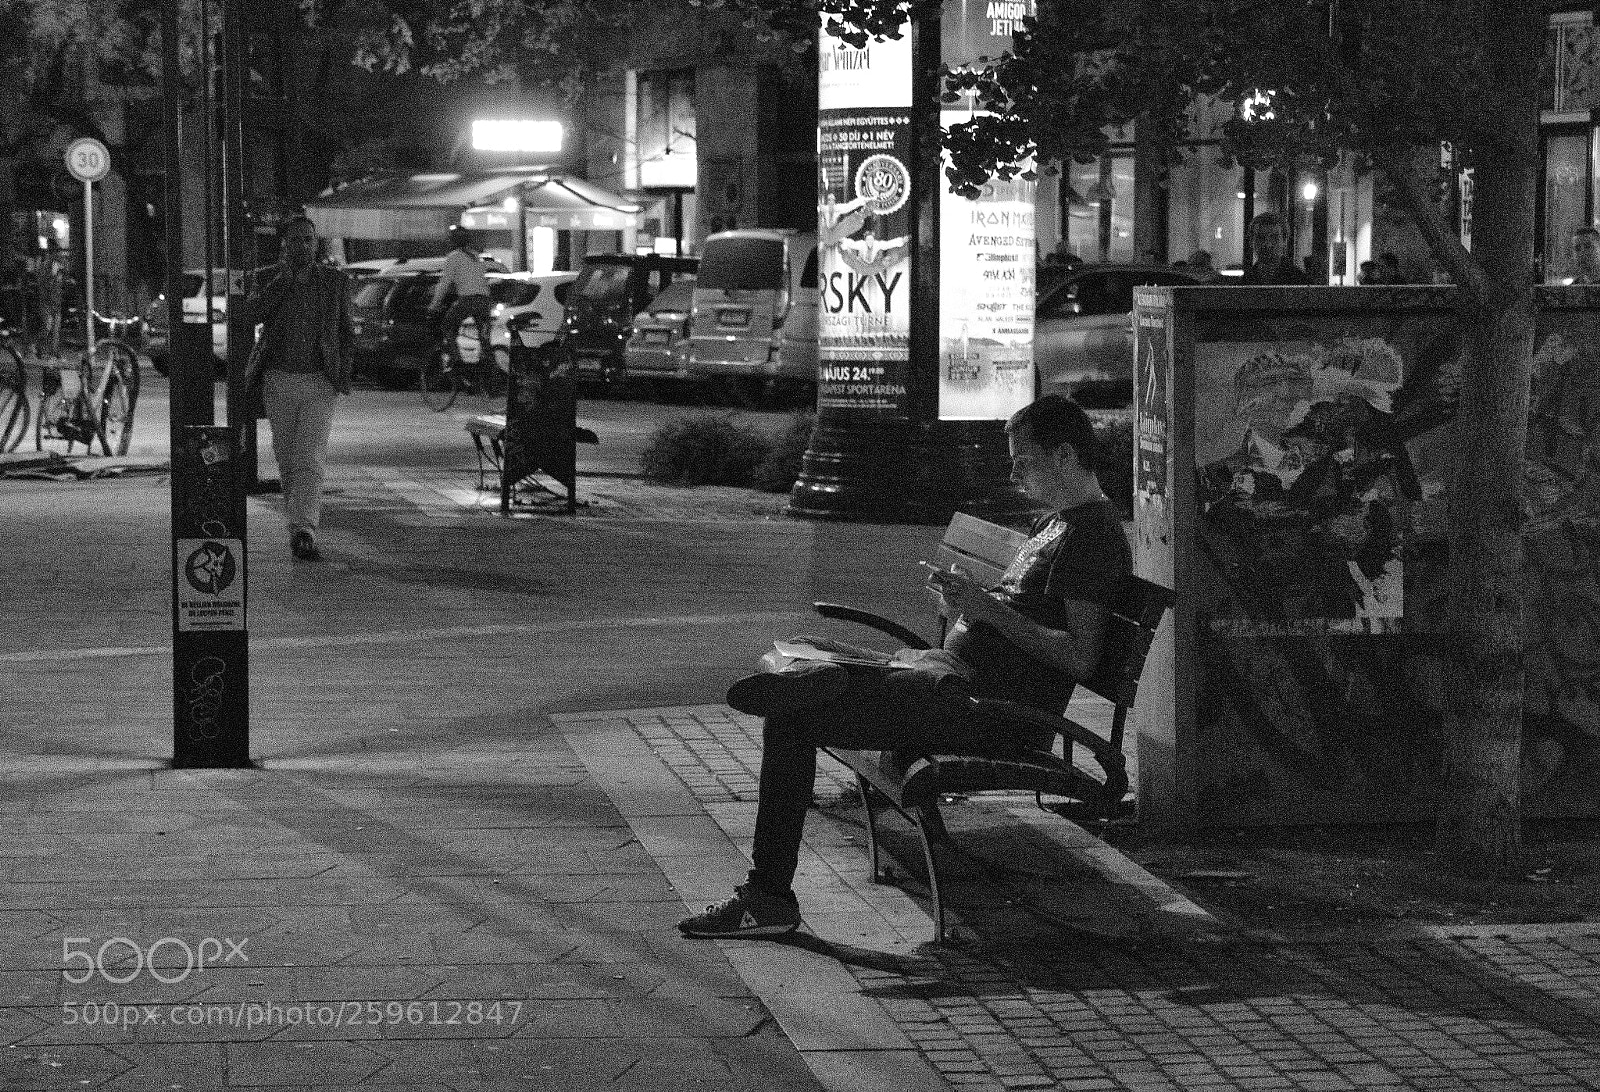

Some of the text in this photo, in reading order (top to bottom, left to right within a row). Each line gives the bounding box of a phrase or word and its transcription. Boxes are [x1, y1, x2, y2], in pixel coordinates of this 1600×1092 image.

[876, 129, 895, 141] NÉV
[78, 152, 99, 168] 30
[873, 171, 893, 189] 80
[970, 210, 1010, 228] IRON
